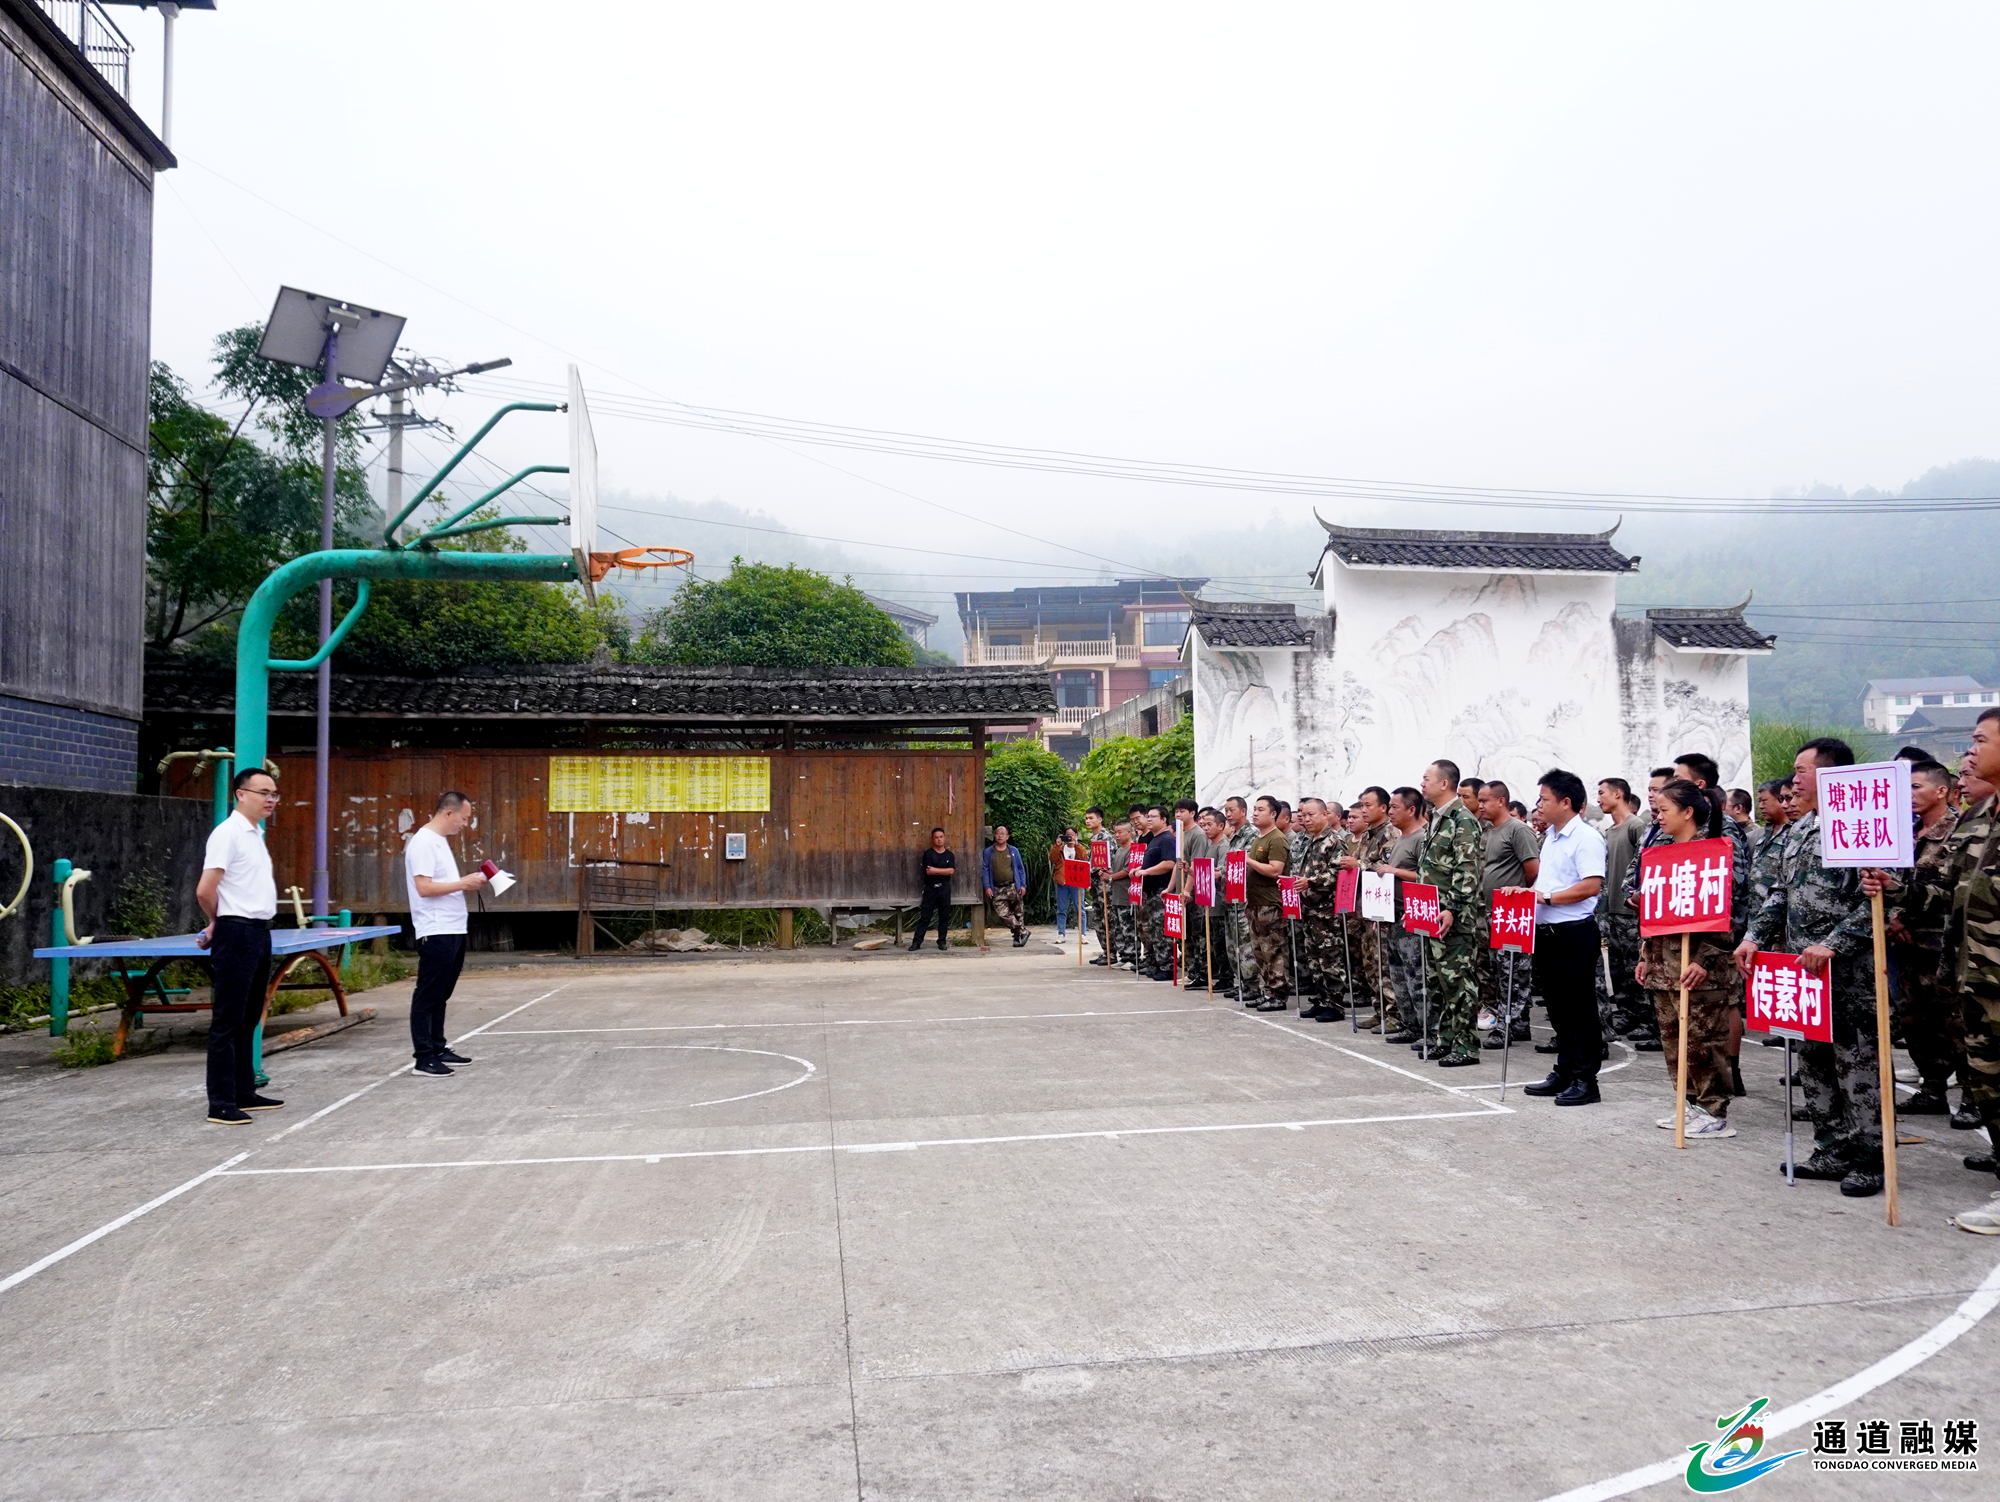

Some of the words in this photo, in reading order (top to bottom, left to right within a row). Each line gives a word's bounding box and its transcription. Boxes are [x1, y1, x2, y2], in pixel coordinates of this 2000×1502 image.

[1827, 778, 1891, 812] 塘冲村
[1831, 817, 1893, 850] 代表队
[1282, 889, 1298, 907] 琵琶村
[1641, 856, 1728, 920] 竹塘村
[1167, 916, 1181, 933] 代表队
[1405, 897, 1437, 923] 马家坝村
[1493, 905, 1533, 936] 芋头村
[1751, 964, 1823, 1026] 传素村
